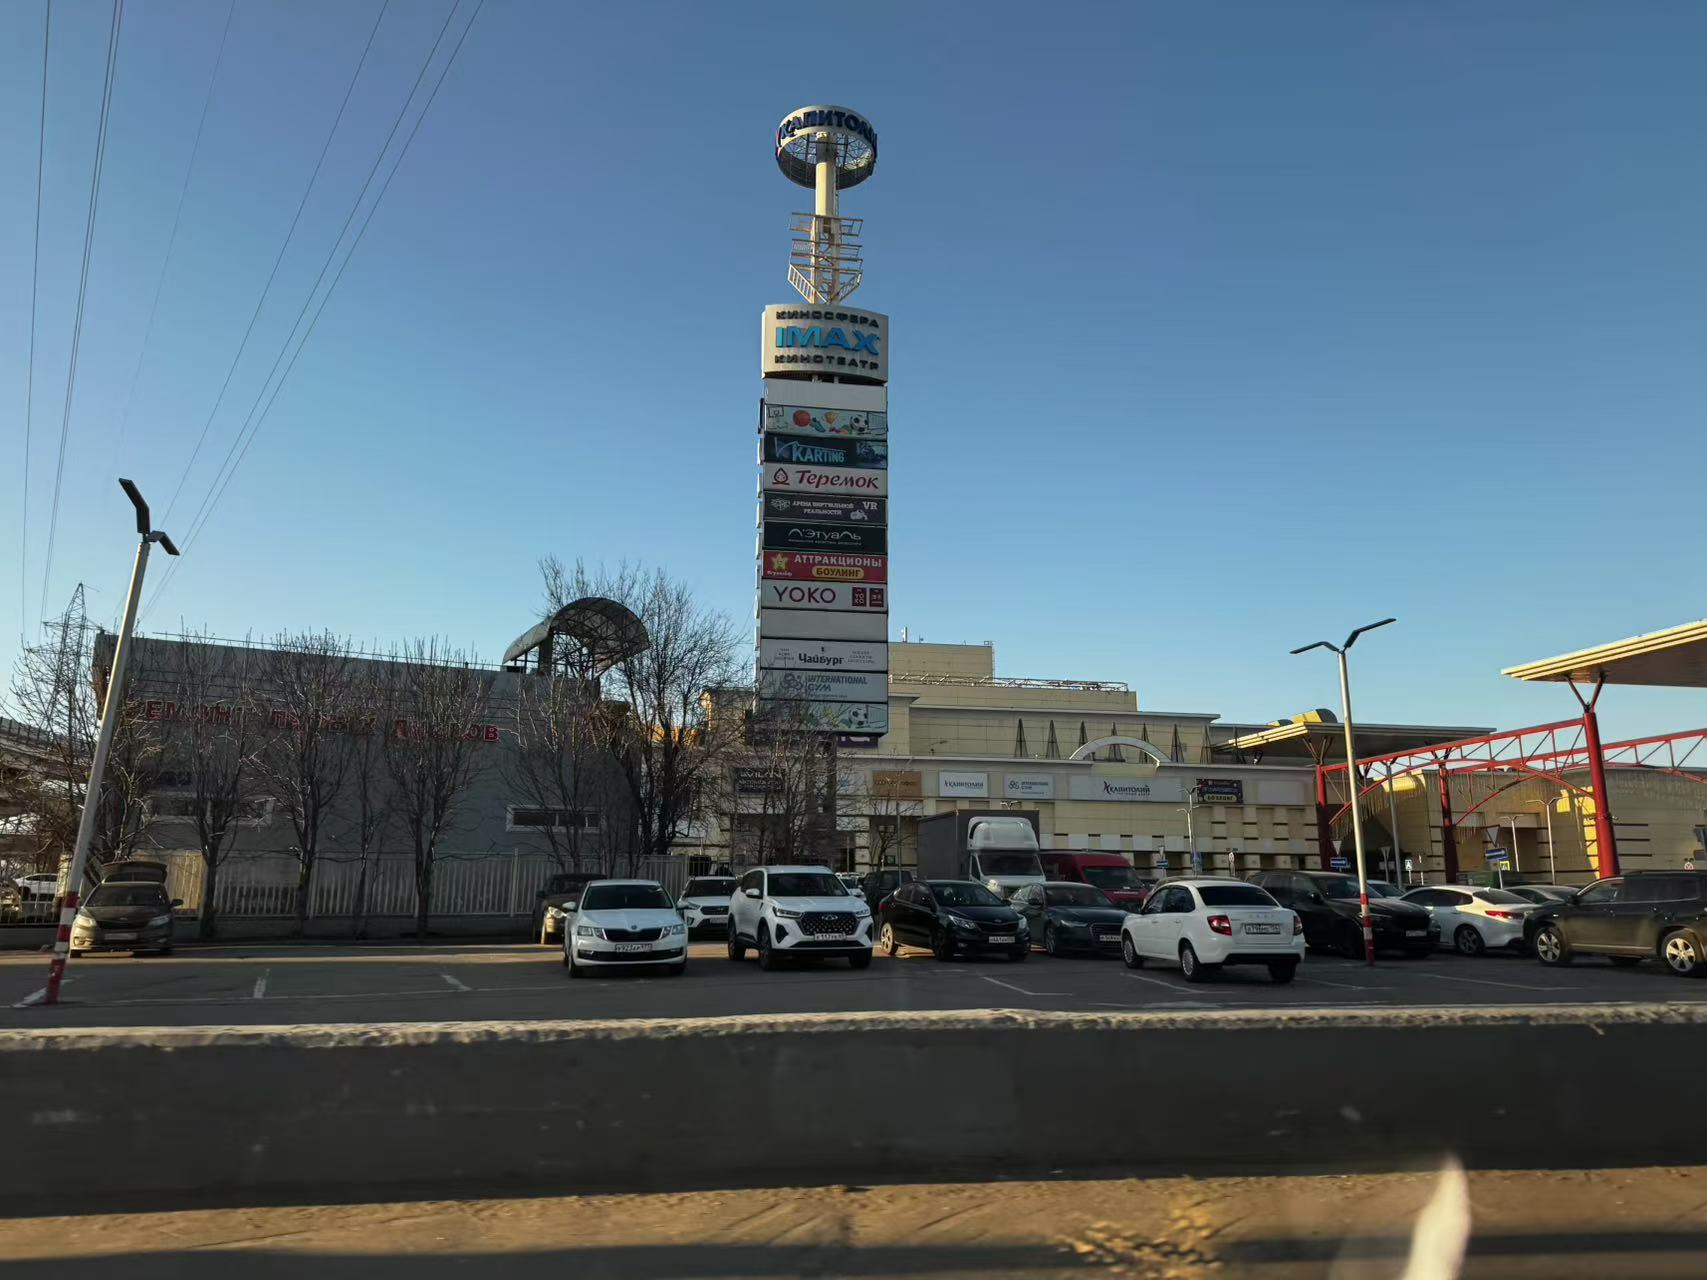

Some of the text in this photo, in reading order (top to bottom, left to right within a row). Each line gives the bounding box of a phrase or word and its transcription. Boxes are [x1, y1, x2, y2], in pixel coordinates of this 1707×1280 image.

[776, 310, 880, 329] КИНОСФЕРА
[775, 325, 880, 356] IMAX
[774, 354, 880, 370] КИНОТЕАТР
[791, 445, 845, 463] KARTING
[795, 470, 879, 490] Теремок
[862, 501, 878, 510] VR
[794, 554, 882, 567] АТТРАКЦИОНЫ
[816, 568, 861, 577] БОУЛИНГ
[773, 585, 836, 604] YOKO
[807, 675, 868, 685] INTERNATIONAL
[807, 683, 831, 692] GYM
